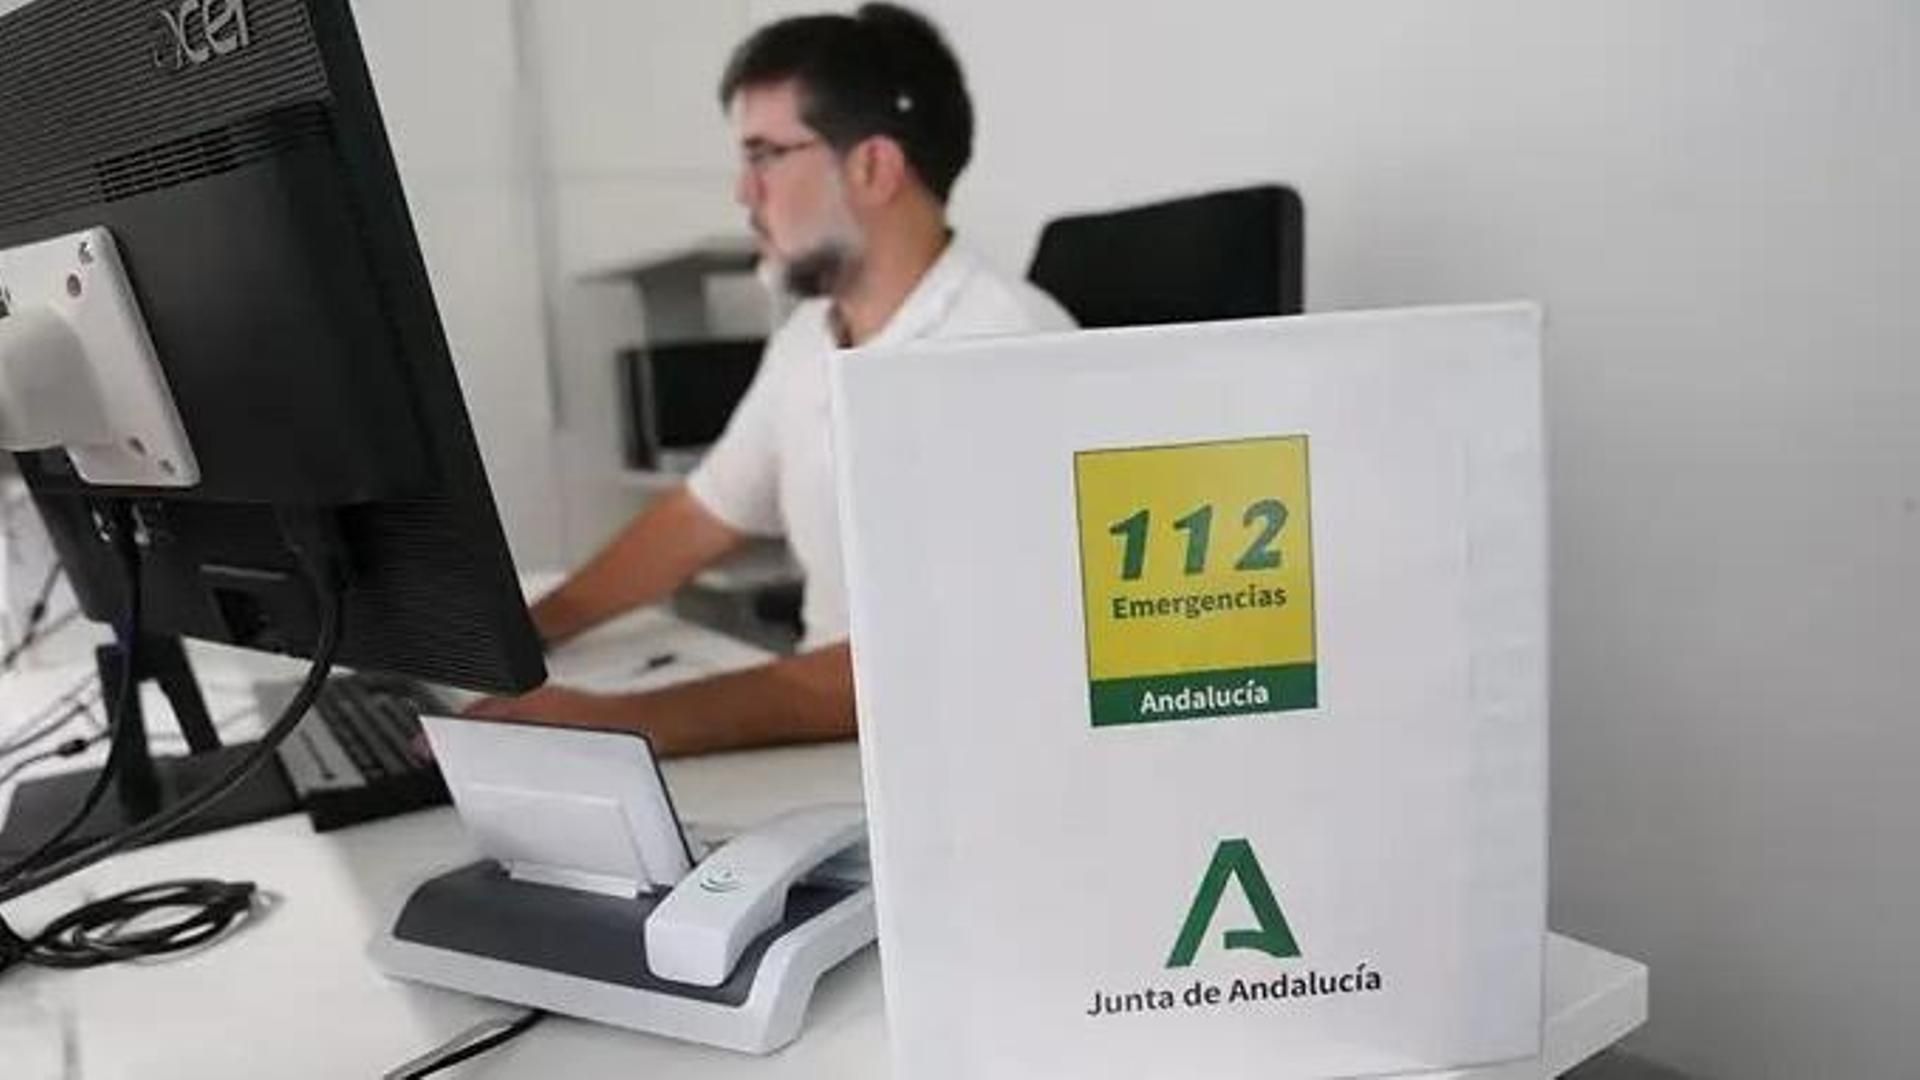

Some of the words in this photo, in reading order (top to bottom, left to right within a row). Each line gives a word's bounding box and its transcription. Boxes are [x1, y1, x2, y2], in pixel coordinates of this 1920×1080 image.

[1109, 498, 1289, 581] 112
[1111, 584, 1287, 620] Emergencias
[1140, 680, 1270, 713] Andalucía
[1087, 989, 1175, 1016] Junta
[1183, 982, 1221, 1007] de
[1228, 963, 1382, 1003] Andalucía
